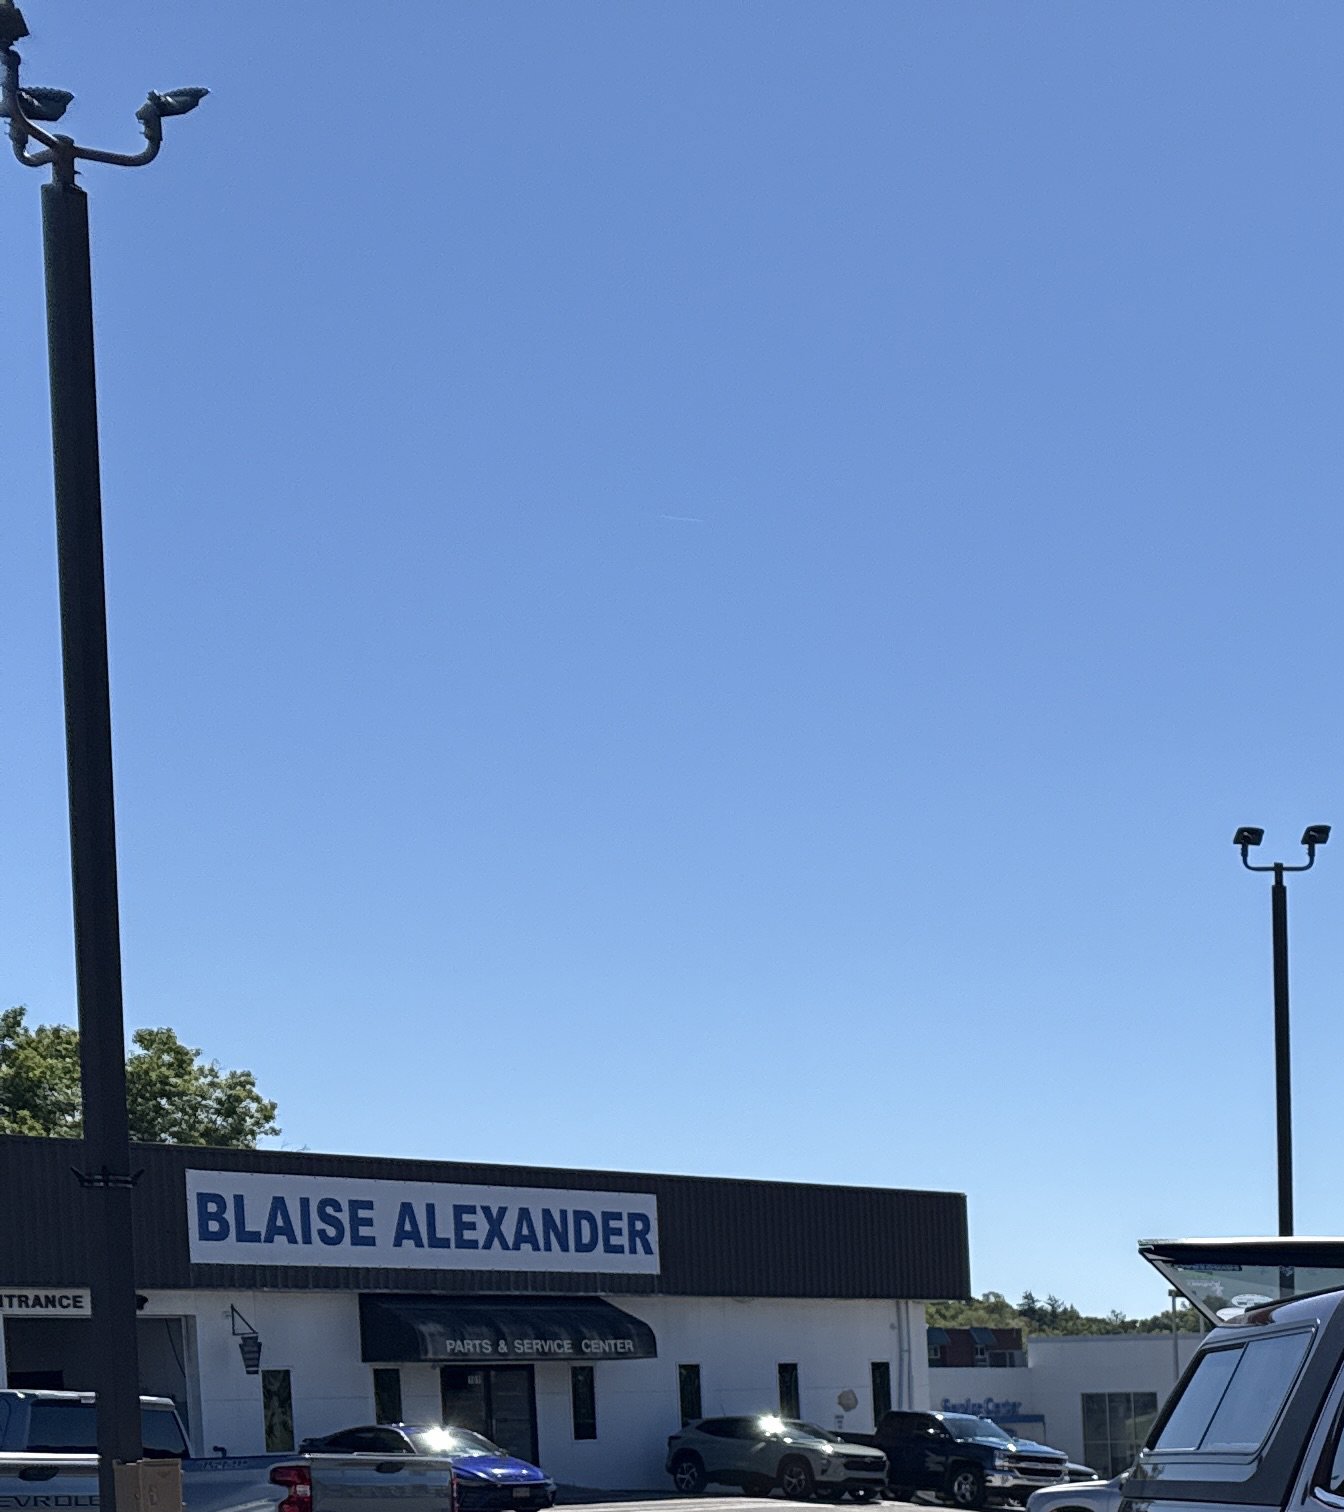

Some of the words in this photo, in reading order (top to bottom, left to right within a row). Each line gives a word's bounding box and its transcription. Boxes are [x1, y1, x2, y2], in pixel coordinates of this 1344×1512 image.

[195, 1192, 377, 1247] BLAISE
[392, 1200, 655, 1256] ALEXANDER
[0, 1294, 84, 1309] TRANCE
[445, 1339, 493, 1353] PARTS
[497, 1339, 508, 1353] &
[514, 1339, 574, 1353] SERVICE
[581, 1339, 635, 1353] CENTER
